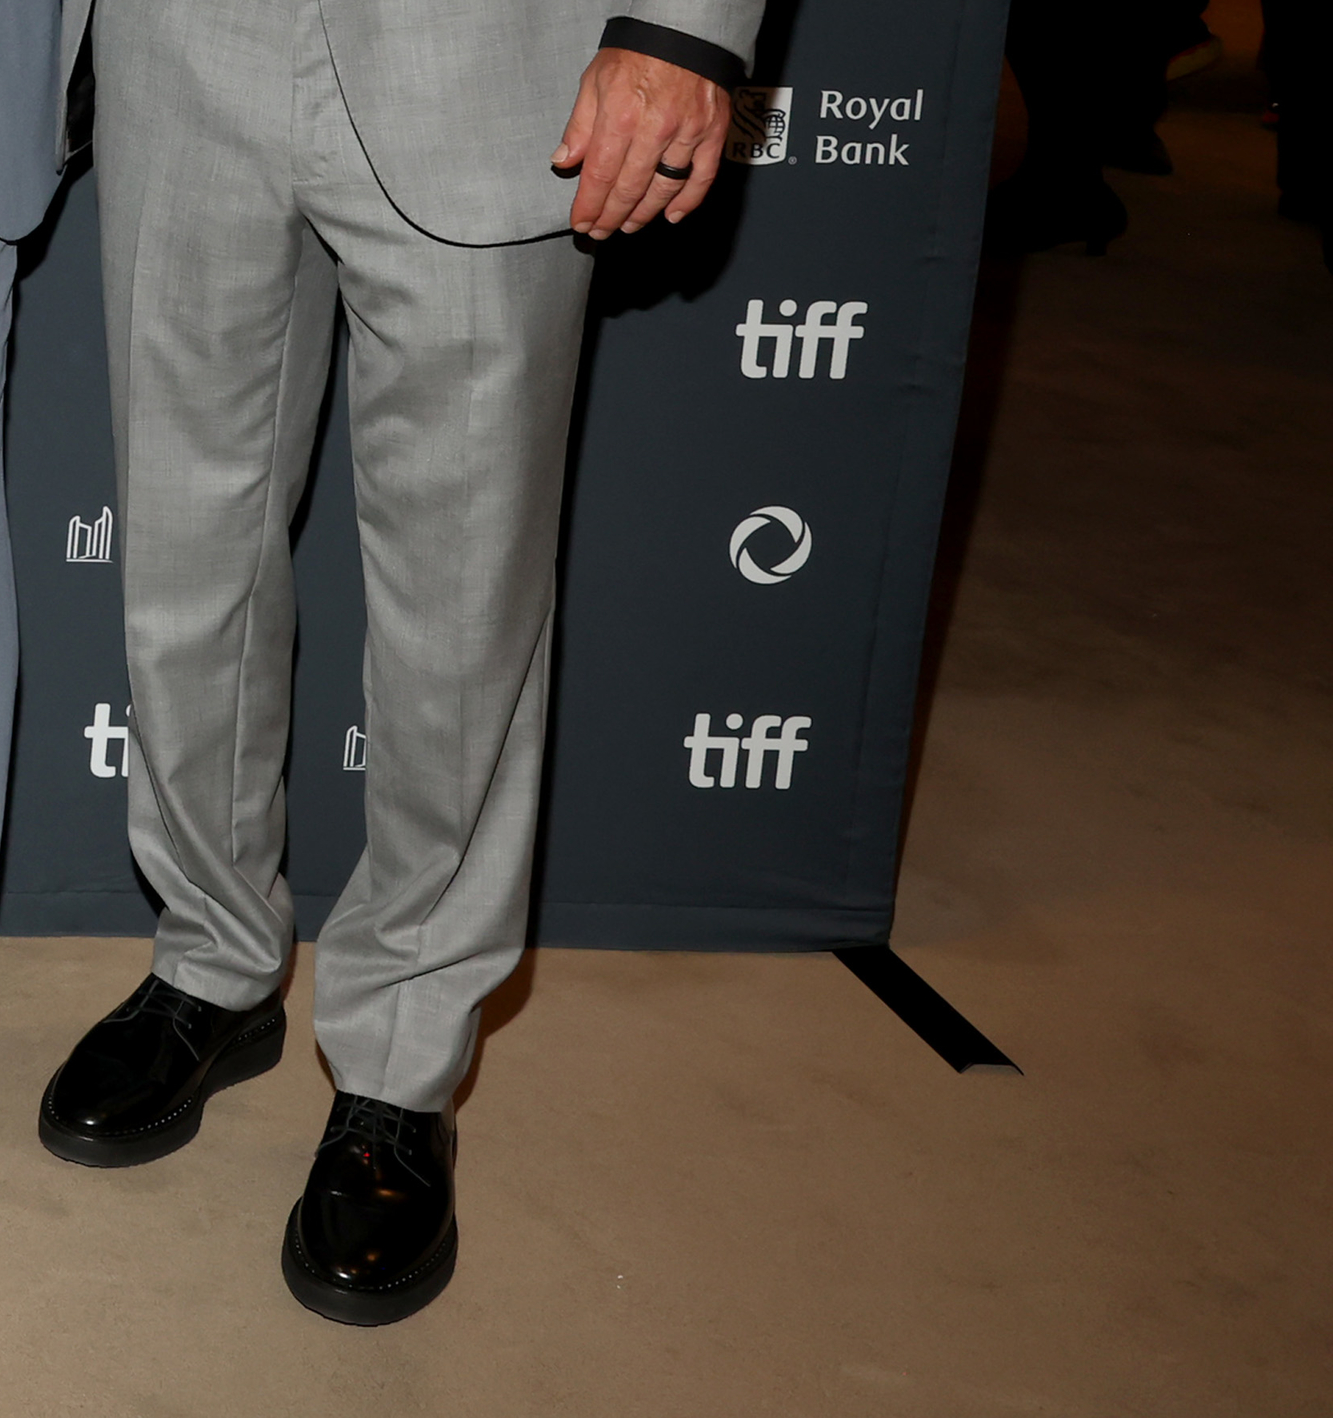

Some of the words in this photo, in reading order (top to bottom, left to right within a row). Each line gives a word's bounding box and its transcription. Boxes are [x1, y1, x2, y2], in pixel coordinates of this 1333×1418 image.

[820, 89, 924, 128] Royal
[815, 133, 909, 166] Bank
[735, 299, 868, 380] tiff
[683, 713, 812, 790] tiff
